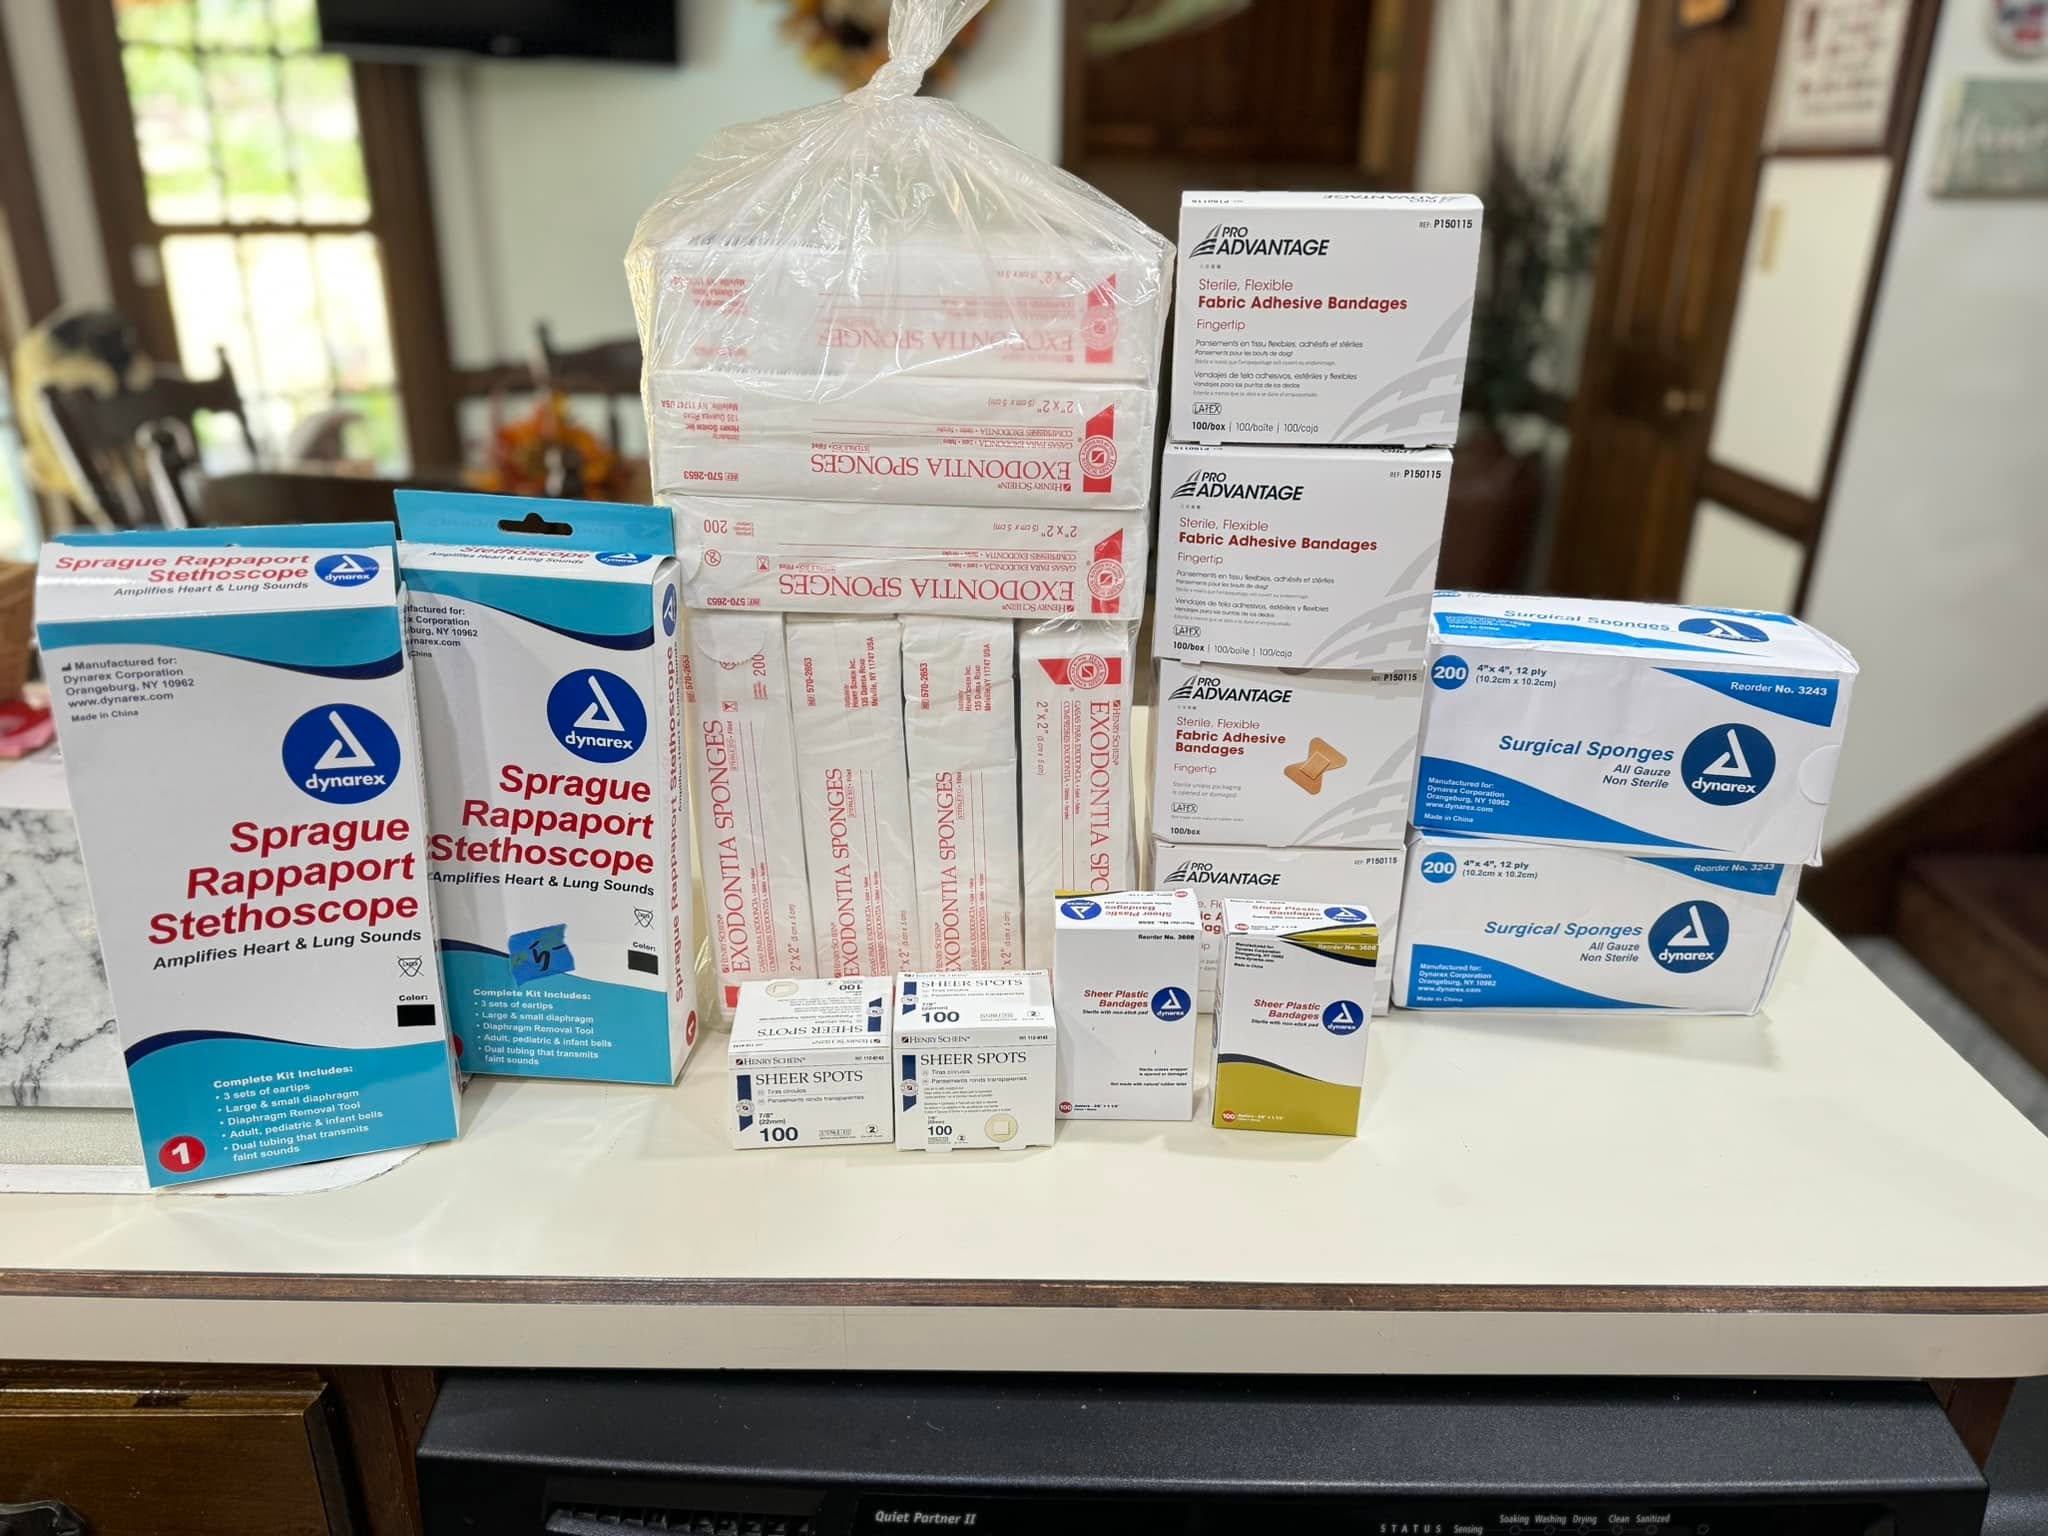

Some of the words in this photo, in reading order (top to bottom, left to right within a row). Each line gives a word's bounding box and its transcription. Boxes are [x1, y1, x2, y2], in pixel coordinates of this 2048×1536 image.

[1221, 226, 1248, 238] PRO
[1433, 219, 1473, 230] P150115
[1216, 238, 1330, 257] ADVANTAGE
[1199, 278, 1241, 293] Sterile,
[1244, 278, 1294, 292] Flexible
[1198, 295, 1246, 310] Fabric
[1250, 296, 1323, 311] Adhesive
[1327, 296, 1408, 313] Bandages
[1196, 318, 1246, 332] Fingertip
[809, 453, 920, 476] SPONGES
[927, 458, 1072, 480] EXODONTIA
[1202, 472, 1227, 483] PRO
[1403, 469, 1442, 480] P150115
[1196, 484, 1305, 501] ADVANTAGE
[703, 519, 728, 534] 200
[1179, 516, 1219, 531] Sterile,
[1222, 518, 1269, 532] Flexible
[1179, 531, 1224, 546] Fabric
[1228, 533, 1297, 549] Adhesive
[1301, 537, 1377, 553] Bandages
[56, 555, 167, 571] Sprague
[174, 553, 310, 569] Rappaport
[1177, 551, 1224, 566] Fingertip
[147, 566, 309, 583] Stethoscope
[324, 572, 371, 583] dynarex
[113, 585, 174, 597] Amplifies
[177, 584, 213, 595] Heart
[215, 583, 225, 592] &
[228, 582, 260, 593] Lung
[262, 580, 309, 591] Sounds
[778, 573, 903, 599] SPONGES
[911, 578, 1075, 601] EXODONTIA
[1503, 609, 1582, 623] Surgical
[1587, 615, 1671, 633] Sponges
[74, 657, 155, 670] Manufactured
[157, 656, 178, 666] for:
[63, 671, 112, 685] Dynarex
[114, 667, 184, 680] Corporation
[1383, 672, 1418, 682] P150115
[1433, 666, 1467, 680] 200
[65, 682, 140, 697] Orangeburg,
[142, 680, 160, 690] NY
[162, 678, 195, 688] 10962
[1197, 676, 1221, 687] PRO
[1475, 675, 1511, 685] (10.2cm
[1521, 678, 1557, 688] 10.2cm)
[1730, 680, 1771, 694] Reorder
[1774, 683, 1796, 694] No.
[1798, 684, 1828, 697] 3243
[68, 691, 174, 708] www.dynarex.com
[1192, 687, 1293, 703] ADVANTAGE
[1176, 716, 1214, 729] Sterile,
[1217, 717, 1261, 730] Flexible
[564, 731, 633, 750] dynarex
[1175, 729, 1219, 743] Fabric
[1222, 732, 1287, 745] Adhesive
[1175, 741, 1245, 757] Bandages
[1498, 734, 1582, 758] Surgical
[1585, 741, 1675, 764] Sponges
[703, 720, 735, 830] SPONGES
[1089, 700, 1110, 848] EXODONTIA
[1173, 762, 1217, 775] Fingertip
[1612, 763, 1632, 776] All
[1634, 765, 1672, 778] Gauze
[304, 772, 386, 793] dynarex
[499, 764, 651, 805] Sprague
[1602, 775, 1627, 787] Non
[1630, 777, 1670, 790] Sterile
[1691, 777, 1758, 795] dynarex
[461, 799, 654, 840] Rappaport
[825, 767, 850, 860] SPONGES
[229, 817, 411, 859] Sprague
[429, 833, 655, 876] Stethoscope
[1365, 856, 1398, 865] P150115
[1190, 861, 1213, 871] PRO
[1423, 861, 1455, 874] 200
[186, 852, 416, 900] Rappaport
[432, 871, 501, 886] Amplifies
[504, 873, 545, 887] Heart
[548, 875, 559, 887] &
[562, 876, 599, 893] Lung
[603, 878, 655, 896] Sounds
[1186, 871, 1281, 886] ADVANTAGE
[717, 836, 751, 973] EXODONTIA
[147, 895, 419, 946] Stethoscope
[834, 863, 861, 978] EXODONTIA
[1483, 920, 1561, 940] Surgical
[1566, 921, 1644, 941] Sponges
[153, 945, 238, 971] Amplifies
[242, 939, 290, 958] Heart
[295, 936, 308, 951] &
[312, 934, 355, 951] Lung
[359, 929, 422, 945] Sounds
[632, 941, 657, 952] Color:
[1588, 941, 1606, 952] All
[1608, 942, 1641, 953] Gauze
[1579, 952, 1601, 963] Non
[1603, 952, 1640, 964] Sterile
[1658, 948, 1717, 964] dynarex
[838, 984, 862, 992] 100
[921, 980, 972, 988] SHEER
[398, 993, 429, 1002] Color:
[472, 988, 523, 997] Complete
[525, 989, 541, 998] Kit
[544, 990, 592, 1000] Includes:
[1083, 989, 1113, 999] Sheer
[1115, 990, 1149, 999] Plastic
[1099, 999, 1149, 1009] Bandages
[1253, 998, 1284, 1009] Sheer
[1285, 1001, 1321, 1011] Plastic
[921, 1011, 960, 1023] 100
[1268, 1009, 1320, 1022] Bandages
[757, 1027, 807, 1037] SPOTS
[811, 1024, 864, 1034] SHEER
[1327, 1023, 1357, 1031] dynarex
[920, 1053, 973, 1066] SHEER
[976, 1051, 1027, 1064] SPOTS
[213, 1073, 273, 1089] Complete
[276, 1071, 296, 1081] Kit
[298, 1064, 354, 1078] Includes:
[755, 1072, 809, 1086] SHEER
[813, 1070, 864, 1084] SPOTS
[225, 1102, 257, 1116] Large
[259, 1100, 269, 1110] &
[270, 1096, 300, 1108] small
[302, 1089, 360, 1105] diaphragm
[226, 1110, 288, 1127] Diaphragm
[289, 1104, 336, 1120] Removal
[338, 1101, 362, 1112] Tool
[231, 1141, 257, 1152] Dual
[259, 1135, 294, 1150] tubing
[296, 1132, 317, 1143] that
[319, 1123, 369, 1140] transmits
[759, 1126, 799, 1142] 100
[927, 1125, 953, 1136] 100
[170, 1141, 191, 1165] 1
[232, 1151, 258, 1163] faint
[260, 1145, 300, 1159] sounds
[875, 1510, 910, 1523] Quiet
[913, 1512, 962, 1524] Partner
[963, 1513, 977, 1525] II
[1499, 1514, 1530, 1525] Soaking
[1534, 1514, 1567, 1525] Washing
[1572, 1514, 1598, 1526] Drying
[1608, 1514, 1631, 1524] Clean
[1635, 1513, 1671, 1524] Sanitized
[1453, 1524, 1484, 1535] Sensing
